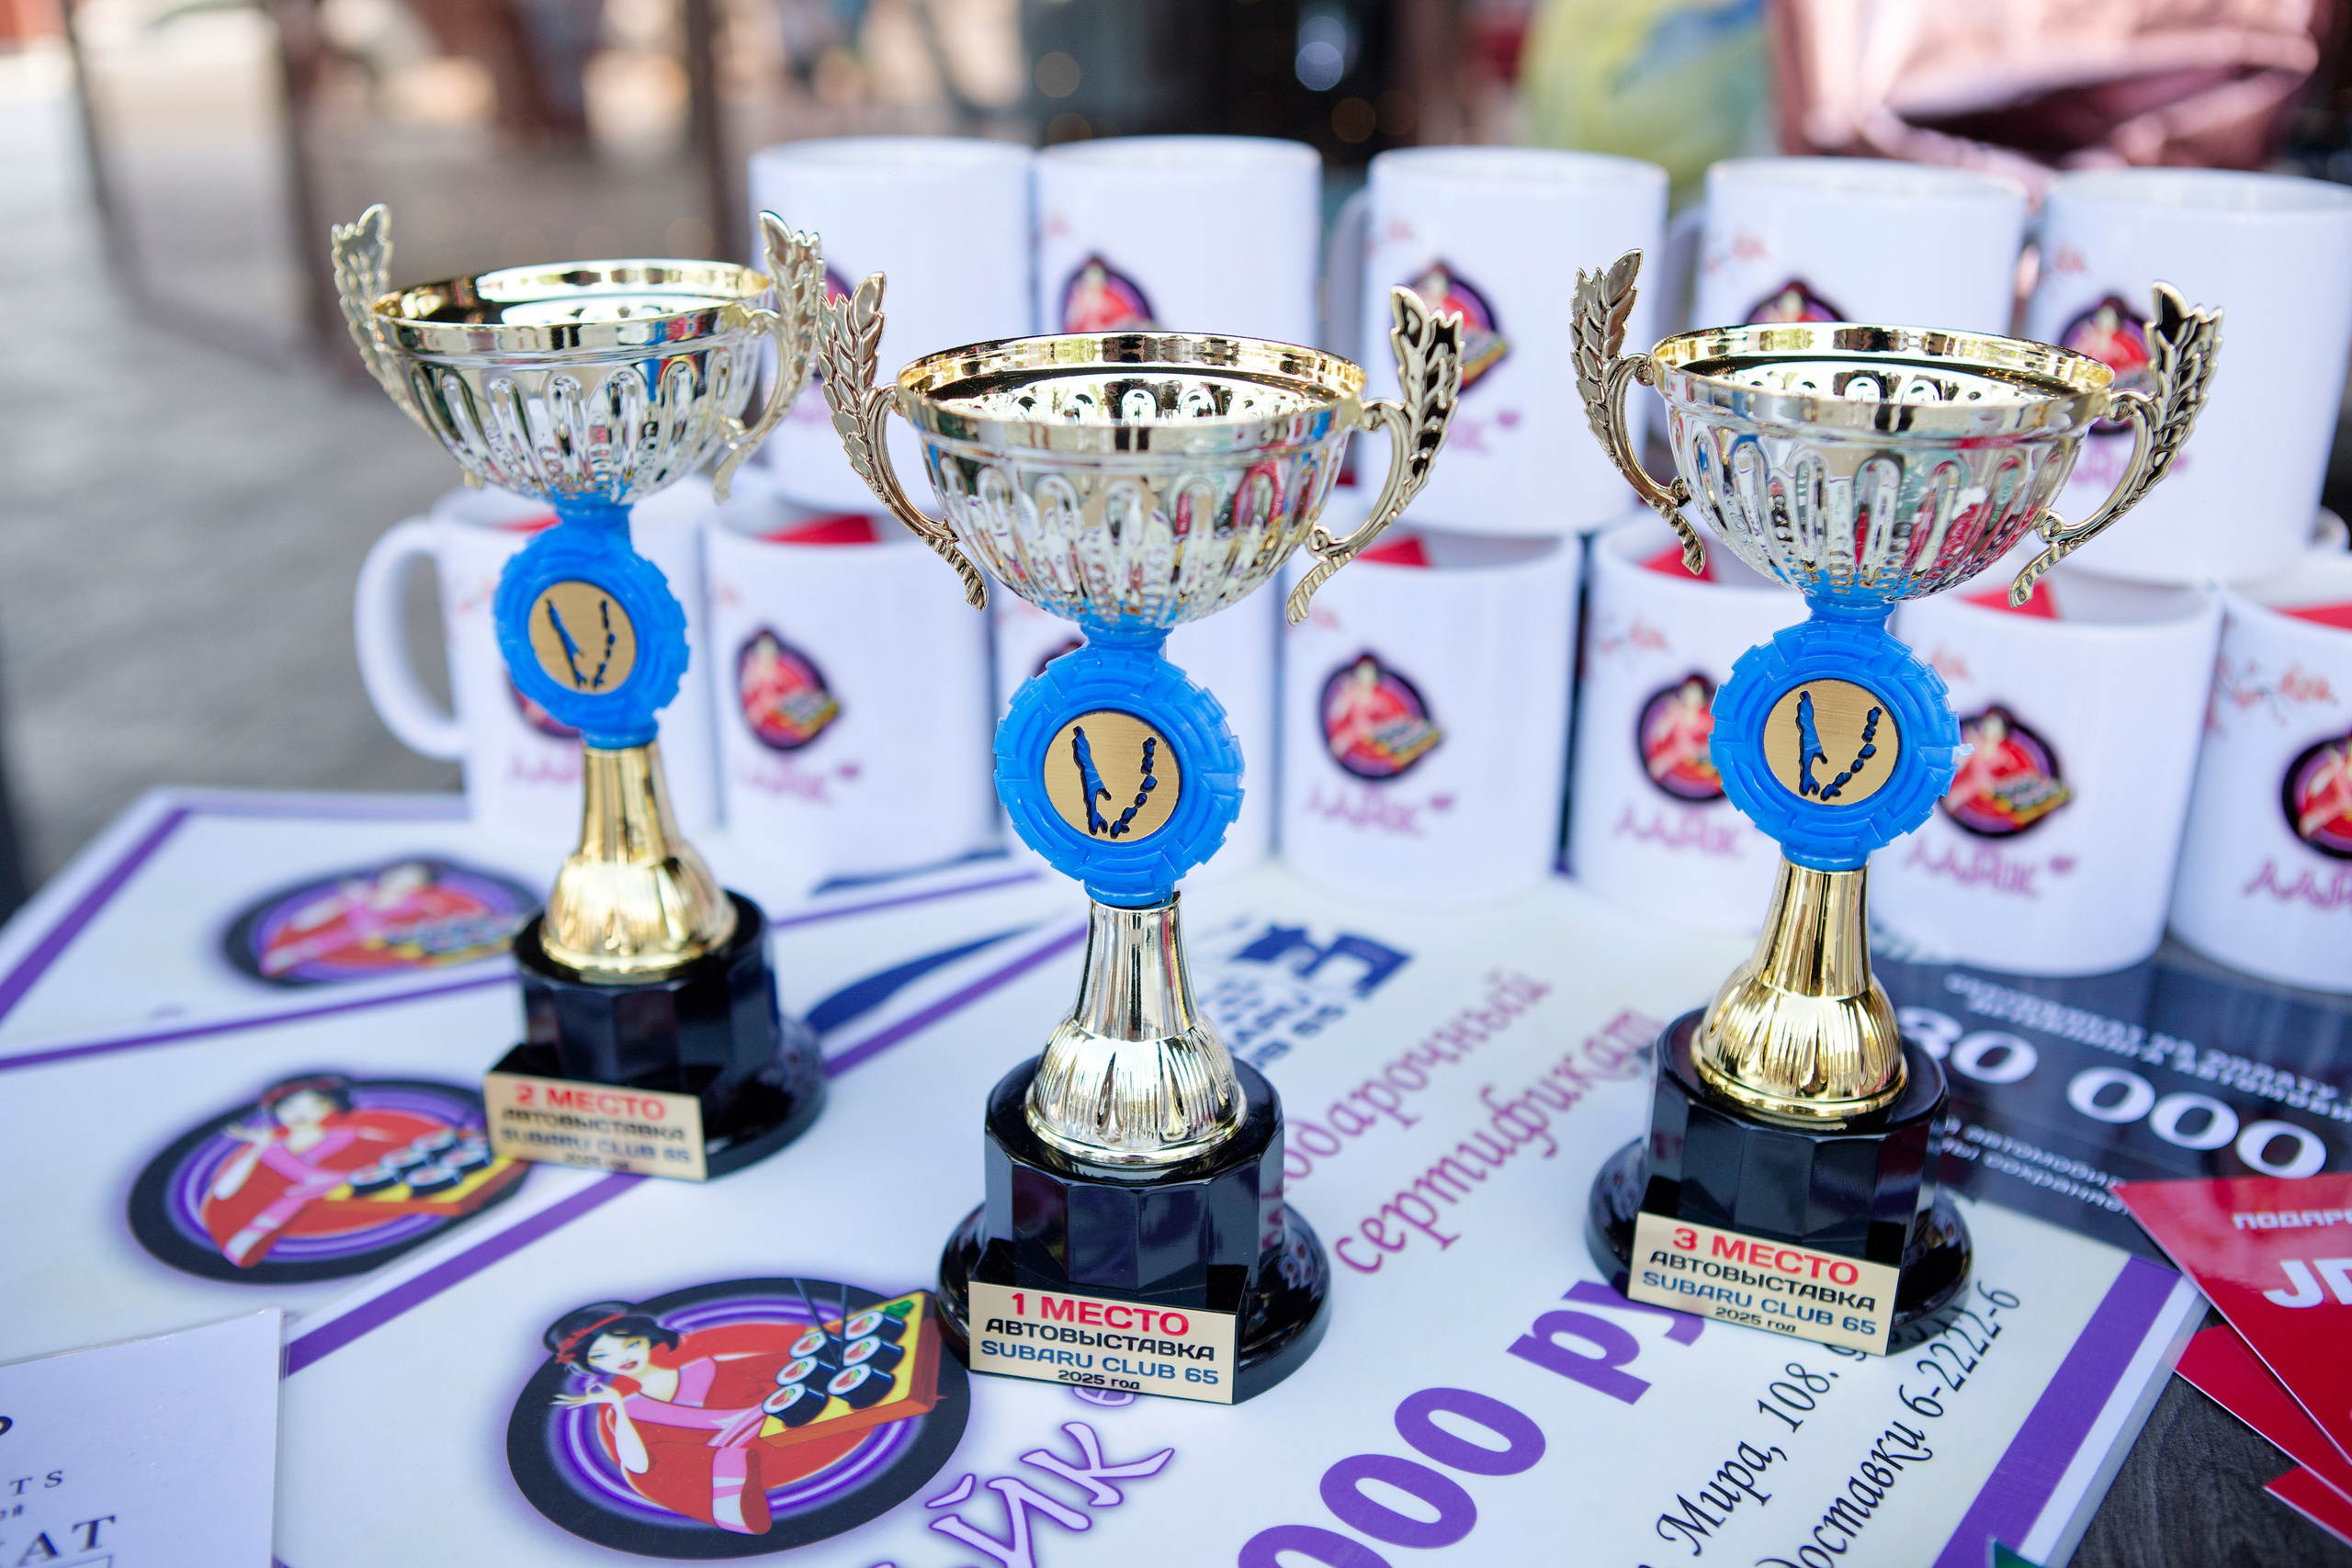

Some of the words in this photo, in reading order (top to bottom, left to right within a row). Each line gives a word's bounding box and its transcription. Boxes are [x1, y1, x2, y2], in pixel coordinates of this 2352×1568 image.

[514, 1082, 536, 1106] 2
[546, 1087, 666, 1122] МЕСТО
[1672, 1227, 1699, 1253] 3
[1712, 1235, 1860, 1287] МЕСТО
[1643, 1270, 1753, 1308] SUBARU
[1760, 1298, 1833, 1326] CLUB
[1842, 1315, 1878, 1337] 65
[1649, 1251, 1876, 1313] АВТОВЫСТАВКА
[1011, 1292, 1025, 1317] 1
[1041, 1296, 1190, 1337] МЕСТО
[1715, 1306, 1762, 1325] 2025
[1767, 1318, 1796, 1335] год
[985, 1318, 1215, 1361] АВТОВЫСТАВКА
[981, 1340, 1093, 1370] SUBARU
[1102, 1357, 1176, 1380] CLUB
[1184, 1367, 1219, 1386] 65
[1057, 1370, 1105, 1386] 2025
[1111, 1377, 1140, 1391] год
[1656, 1439, 1789, 1558] Мира,
